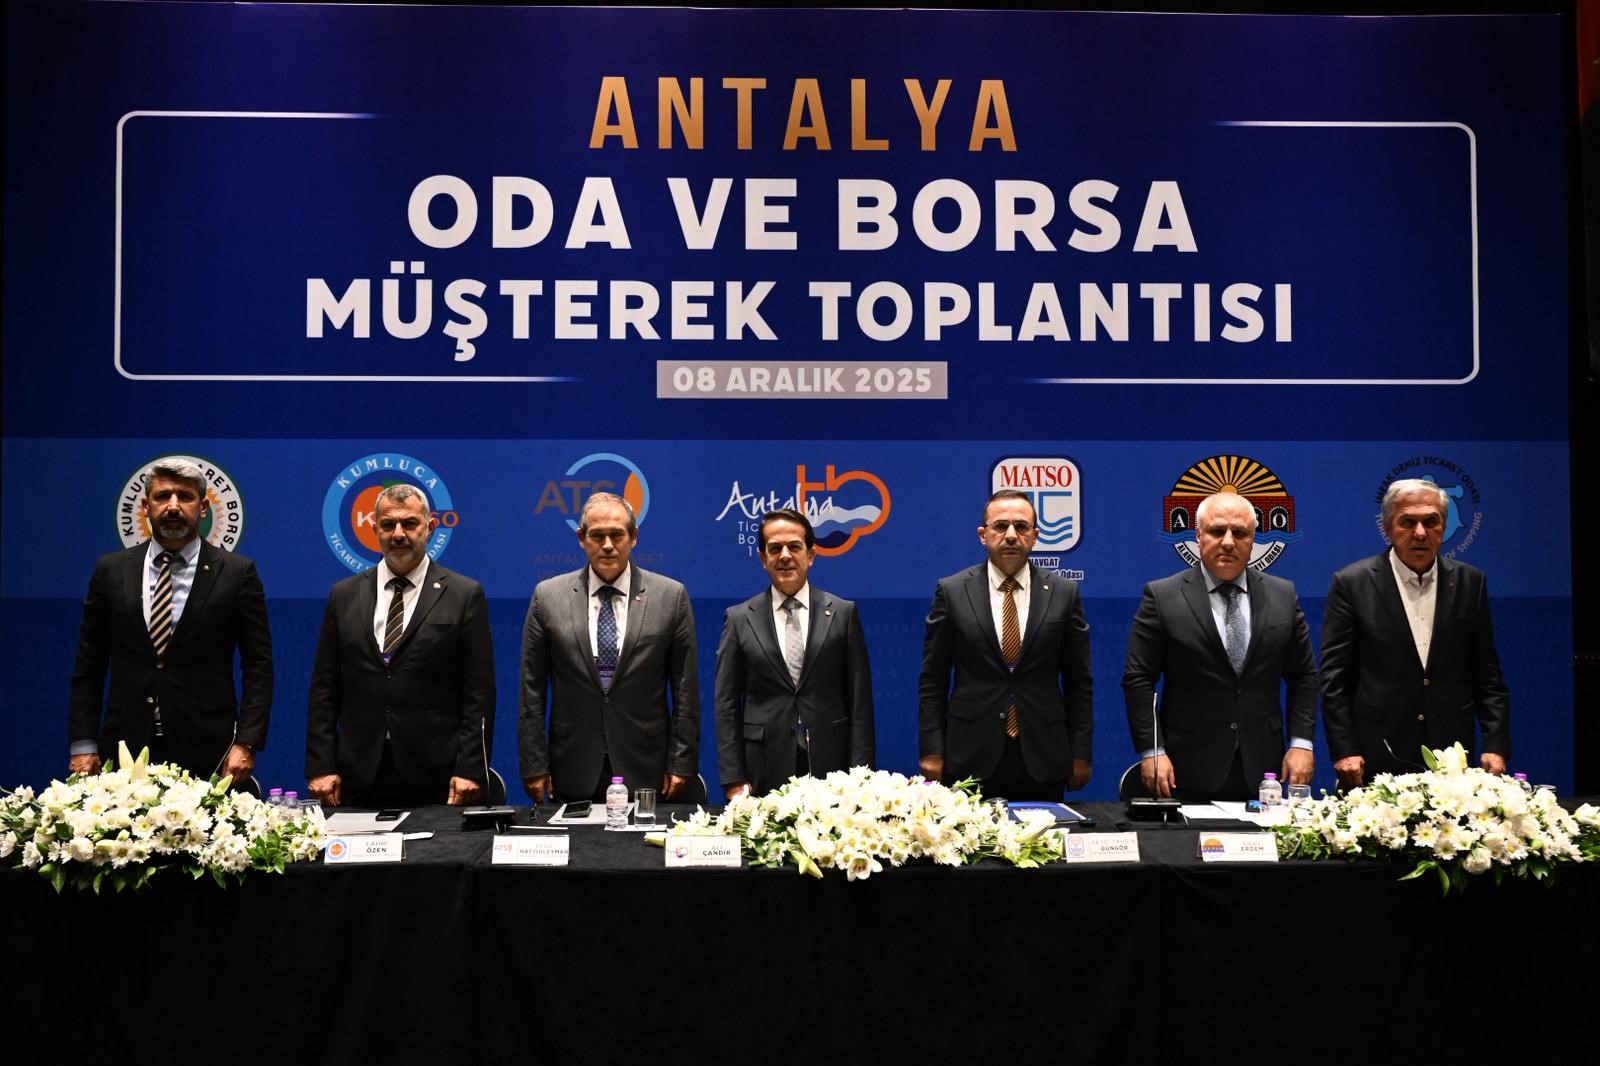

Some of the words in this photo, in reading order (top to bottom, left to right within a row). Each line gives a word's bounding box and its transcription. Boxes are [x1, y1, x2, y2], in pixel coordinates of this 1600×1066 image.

[590, 77, 1017, 152] ANTALYA
[408, 175, 631, 250] ODA
[667, 178, 798, 251] VE
[838, 178, 1197, 253] BORSA
[306, 261, 778, 362] MÜŞTEREK
[809, 280, 1292, 343] TOPLANTISI
[673, 367, 716, 392] 08
[726, 367, 845, 392] ARALIK
[855, 367, 932, 392] 2025
[337, 457, 438, 489] KUMLUCA
[1001, 465, 1073, 488] MATSO
[121, 473, 147, 537] KUMLUC
[427, 533, 447, 558] DASI
[366, 846, 387, 854] ÖZEN
